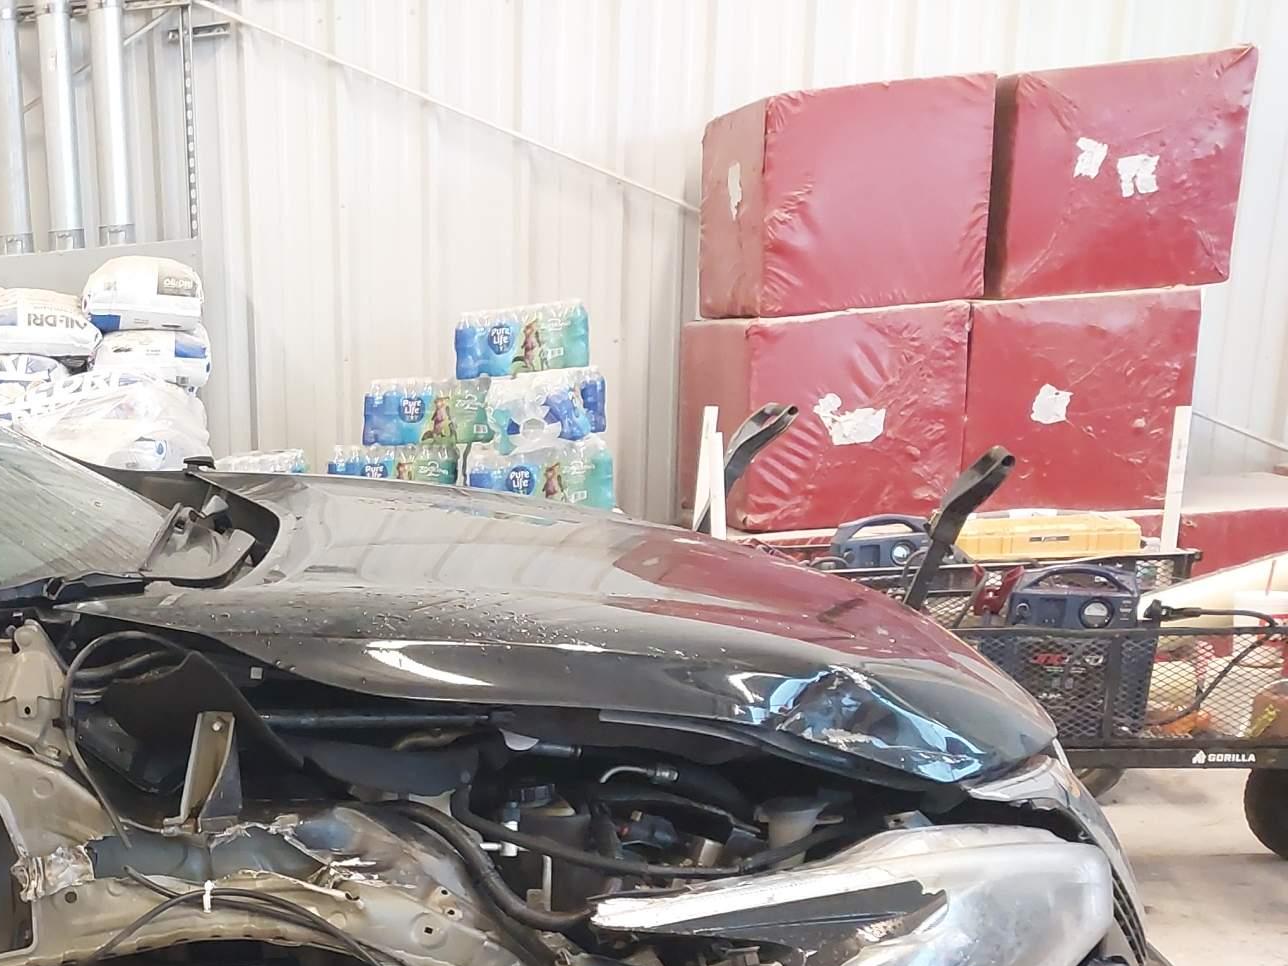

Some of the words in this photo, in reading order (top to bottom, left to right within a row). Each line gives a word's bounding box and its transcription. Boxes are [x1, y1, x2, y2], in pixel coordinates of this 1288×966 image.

[491, 326, 511, 337] Pure
[493, 334, 509, 346] Life
[402, 398, 422, 408] Pure
[404, 406, 420, 415] Life
[509, 470, 530, 480] Pure
[512, 479, 529, 489] Life
[1207, 753, 1256, 762] GORILLA
